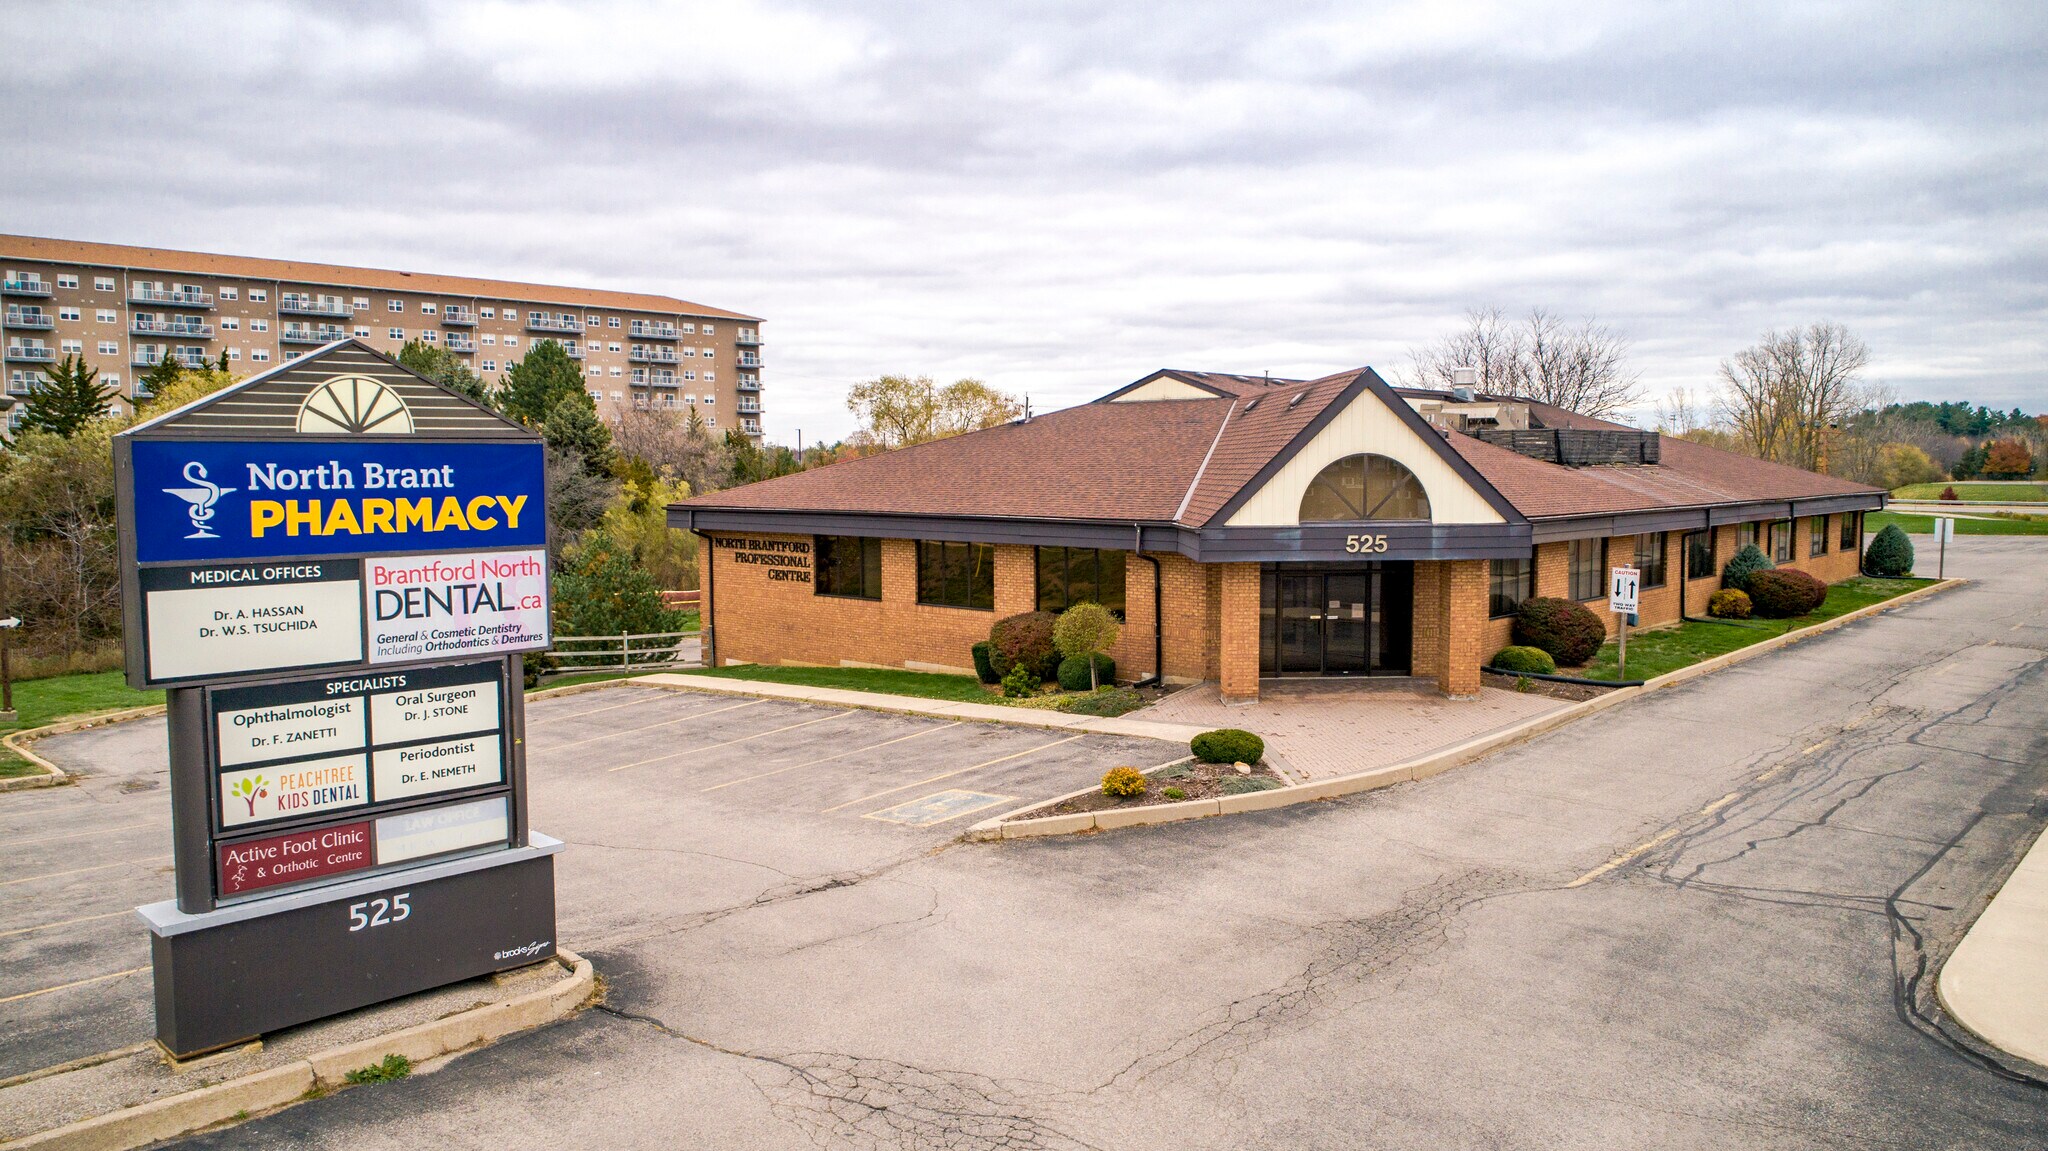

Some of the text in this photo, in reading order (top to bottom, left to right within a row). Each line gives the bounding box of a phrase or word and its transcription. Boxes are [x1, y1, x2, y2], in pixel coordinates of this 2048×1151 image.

[247, 461, 454, 490] North Brant
[251, 495, 528, 538] PHARMACY
[715, 538, 810, 553] NORTH BRANTFORD
[1345, 534, 1388, 553] 525
[735, 552, 810, 568] PROFESSIONAL
[191, 566, 321, 584] MEDICAL OFFICES
[375, 556, 540, 585] Brantford North
[768, 569, 810, 582] CENTRE
[214, 606, 304, 620] Dr. A. HASSAN
[200, 619, 317, 637] Dr. W.S. TSUCHIDA
[377, 622, 522, 644] General & Cosmetic Dentistry
[378, 632, 543, 656] Including Orthodontics & Dentures
[326, 676, 406, 694] SPECIALISTS
[396, 688, 476, 707] Oral Surgeon
[234, 702, 351, 728] Ophthalmologist
[405, 705, 468, 722] Dr. J. STONE
[252, 728, 337, 747] Dr. F. ZANETTI
[401, 743, 474, 762] Periodontist
[280, 766, 354, 791] PEACHTREE
[402, 764, 476, 784] Dr. E. NEMETH
[278, 784, 359, 811] KIDS DENTAL
[226, 829, 364, 866] Active Foot Clinic
[257, 851, 362, 878] & Orthotic Centre
[349, 893, 411, 931] 525
